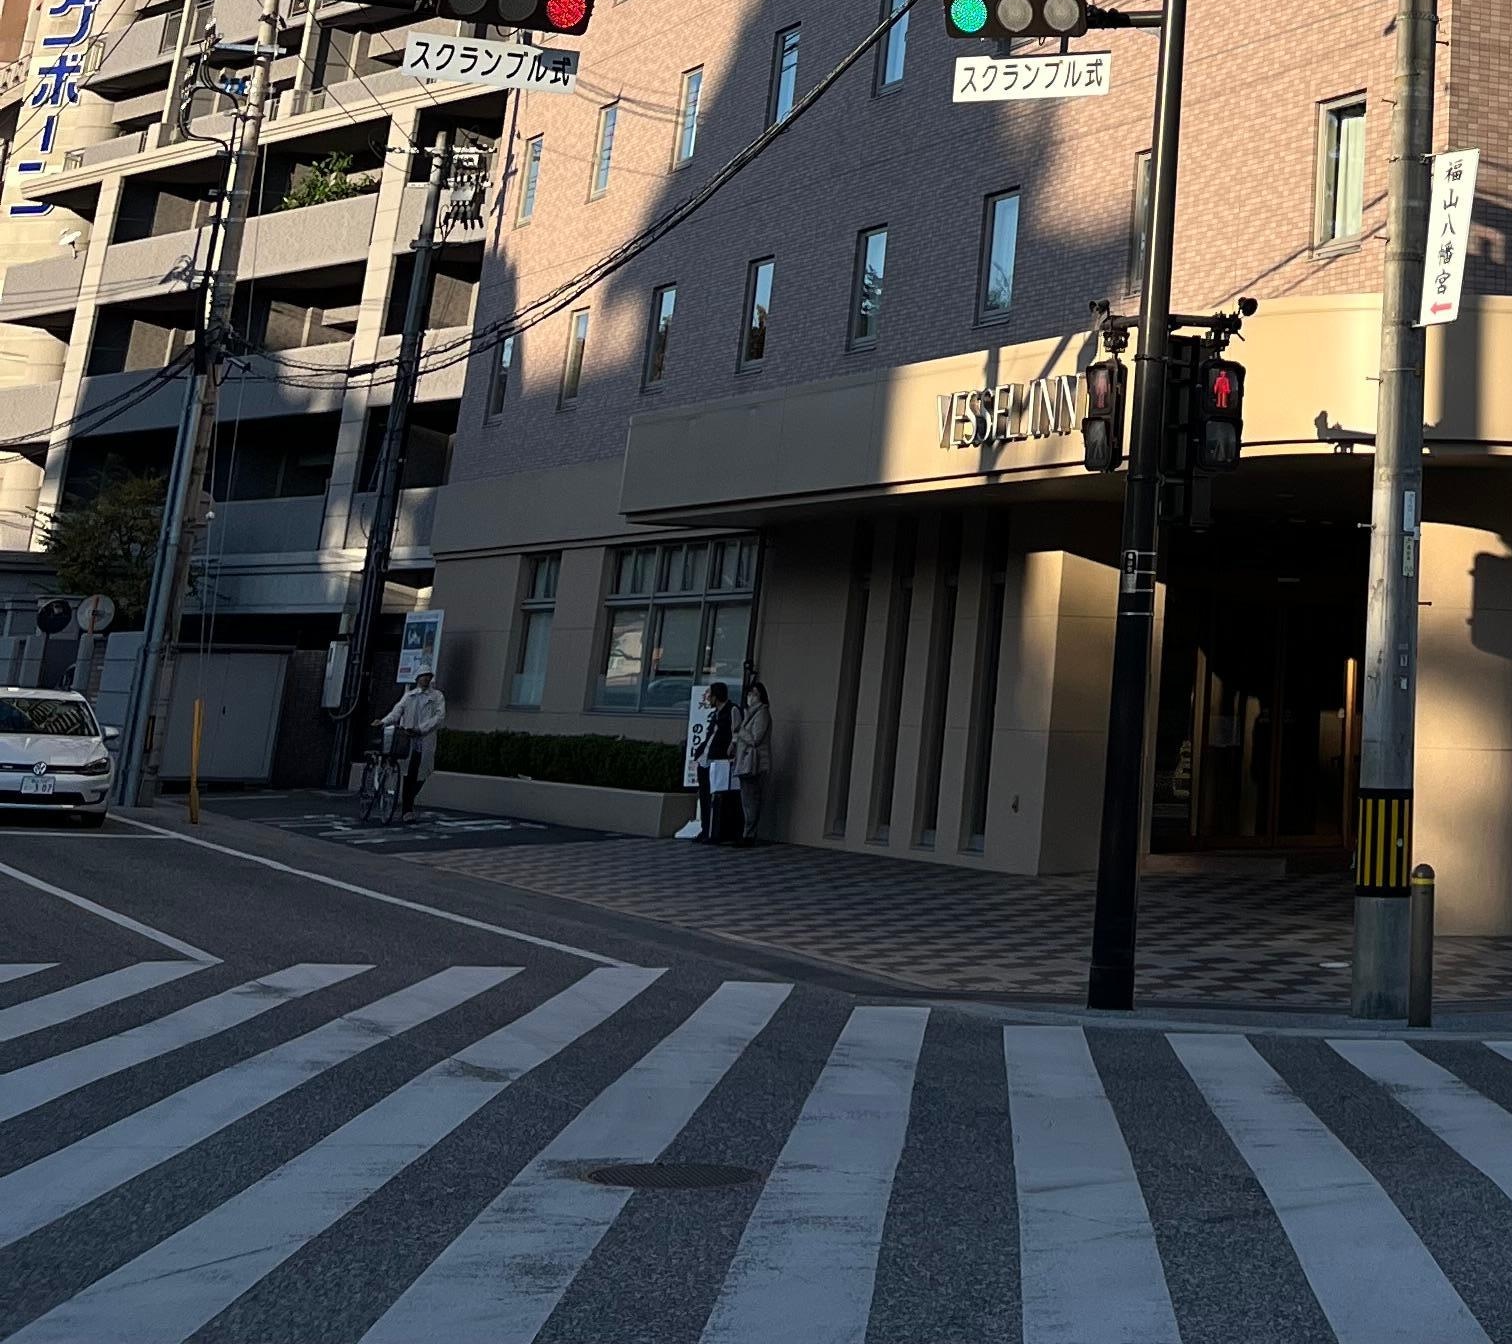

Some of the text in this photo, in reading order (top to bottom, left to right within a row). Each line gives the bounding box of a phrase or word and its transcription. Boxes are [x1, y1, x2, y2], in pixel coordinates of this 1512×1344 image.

[410, 41, 571, 87] スクランブル式
[961, 59, 1104, 93] スクランブル式
[1435, 159, 1463, 295] 福山八幡宮
[936, 372, 1088, 449] VESSEL INN
